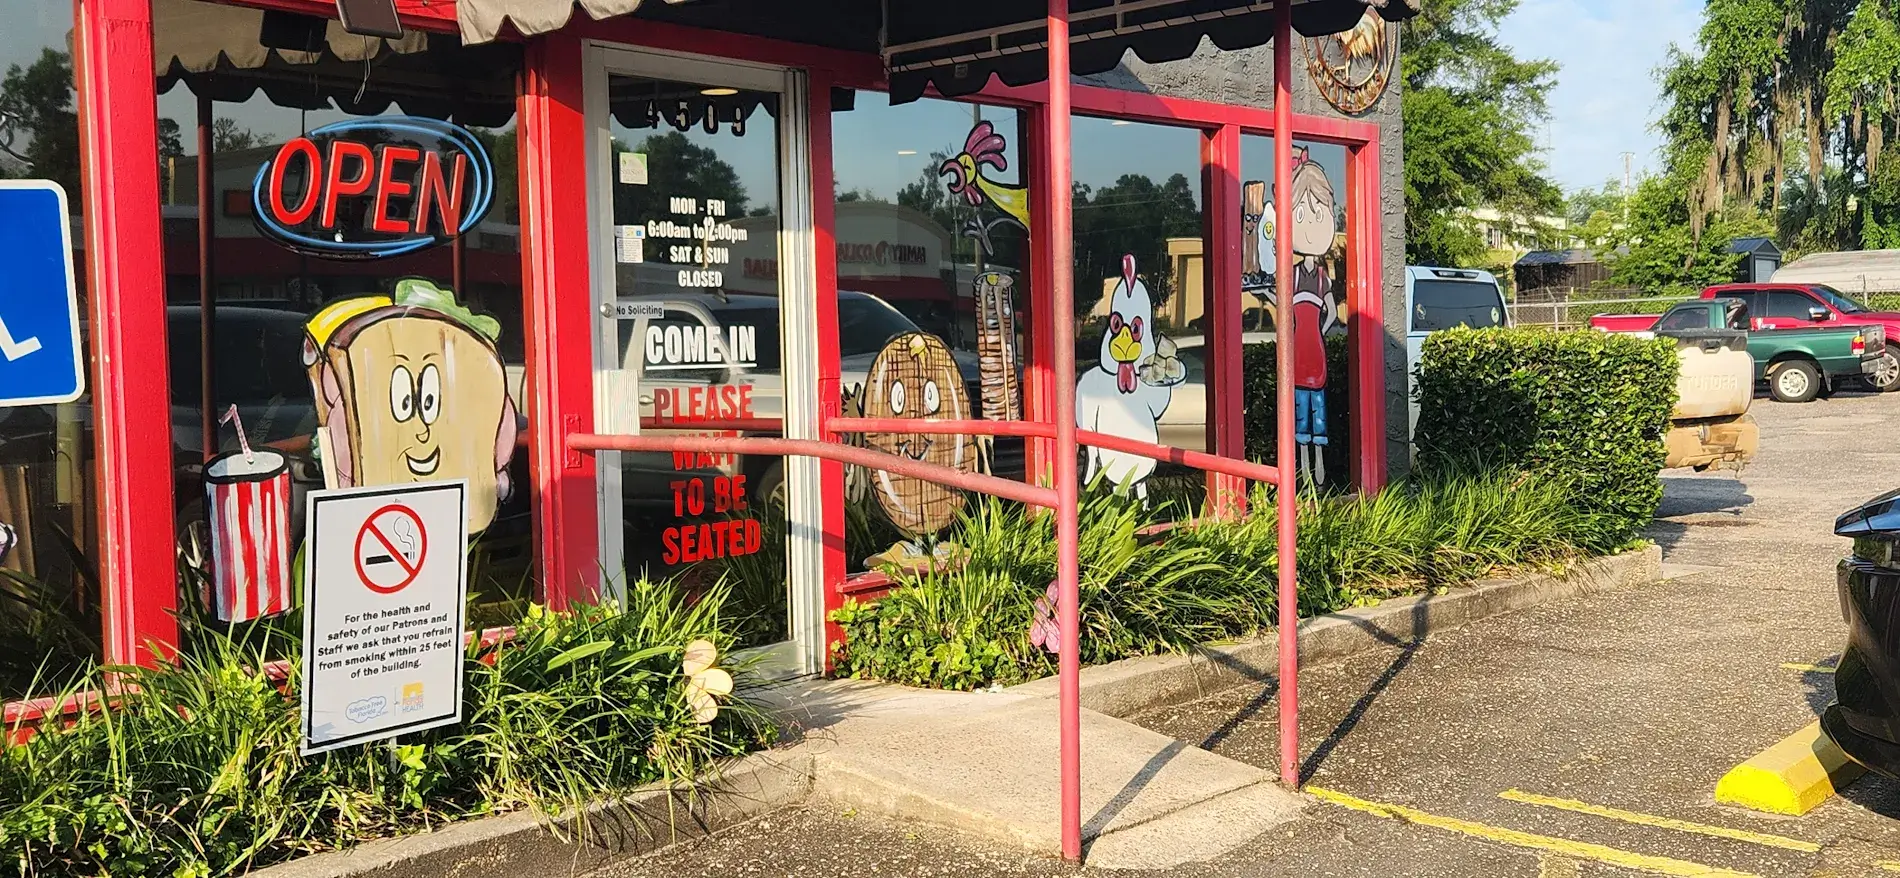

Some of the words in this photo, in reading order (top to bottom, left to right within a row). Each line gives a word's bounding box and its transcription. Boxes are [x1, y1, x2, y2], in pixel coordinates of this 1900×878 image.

[646, 98, 746, 138] 4509
[269, 137, 466, 236] OPEN
[670, 197, 696, 215] MON
[707, 199, 726, 217] FRI
[648, 220, 691, 239] 6:00am
[693, 223, 705, 239] to
[704, 216, 748, 244] 12:00pm
[669, 245, 692, 263] SAT
[694, 246, 703, 264] &
[706, 247, 729, 264] SUN
[678, 270, 723, 288] CLOSED
[616, 304, 627, 316] No
[628, 304, 663, 318] Soliciting
[645, 325, 722, 364] COME
[730, 325, 757, 361] IN
[1683, 375, 1738, 392] TUNDRA
[654, 384, 754, 425] PLEASE
[670, 478, 705, 517] TO
[714, 474, 747, 513] BE
[662, 519, 761, 565] SEATED
[327, 629, 359, 641] safety
[361, 625, 372, 635] of
[374, 624, 390, 633] our
[392, 617, 428, 630] Patrons
[431, 613, 448, 623] and
[345, 614, 360, 624] For
[363, 611, 378, 621] the
[381, 605, 411, 619] health
[413, 602, 431, 613] and
[318, 644, 343, 657] Staff
[346, 643, 359, 652] we
[362, 639, 379, 649] ask
[382, 635, 401, 646] that
[403, 632, 420, 644] you
[422, 626, 453, 639] refrain
[318, 660, 342, 671] from
[345, 651, 386, 666] smoking
[388, 645, 417, 658] within
[419, 643, 431, 653] 25
[433, 639, 452, 650] feet
[350, 669, 361, 679] of
[363, 666, 379, 677] the
[381, 659, 422, 673] building.
[402, 702, 424, 713] HEALTH
